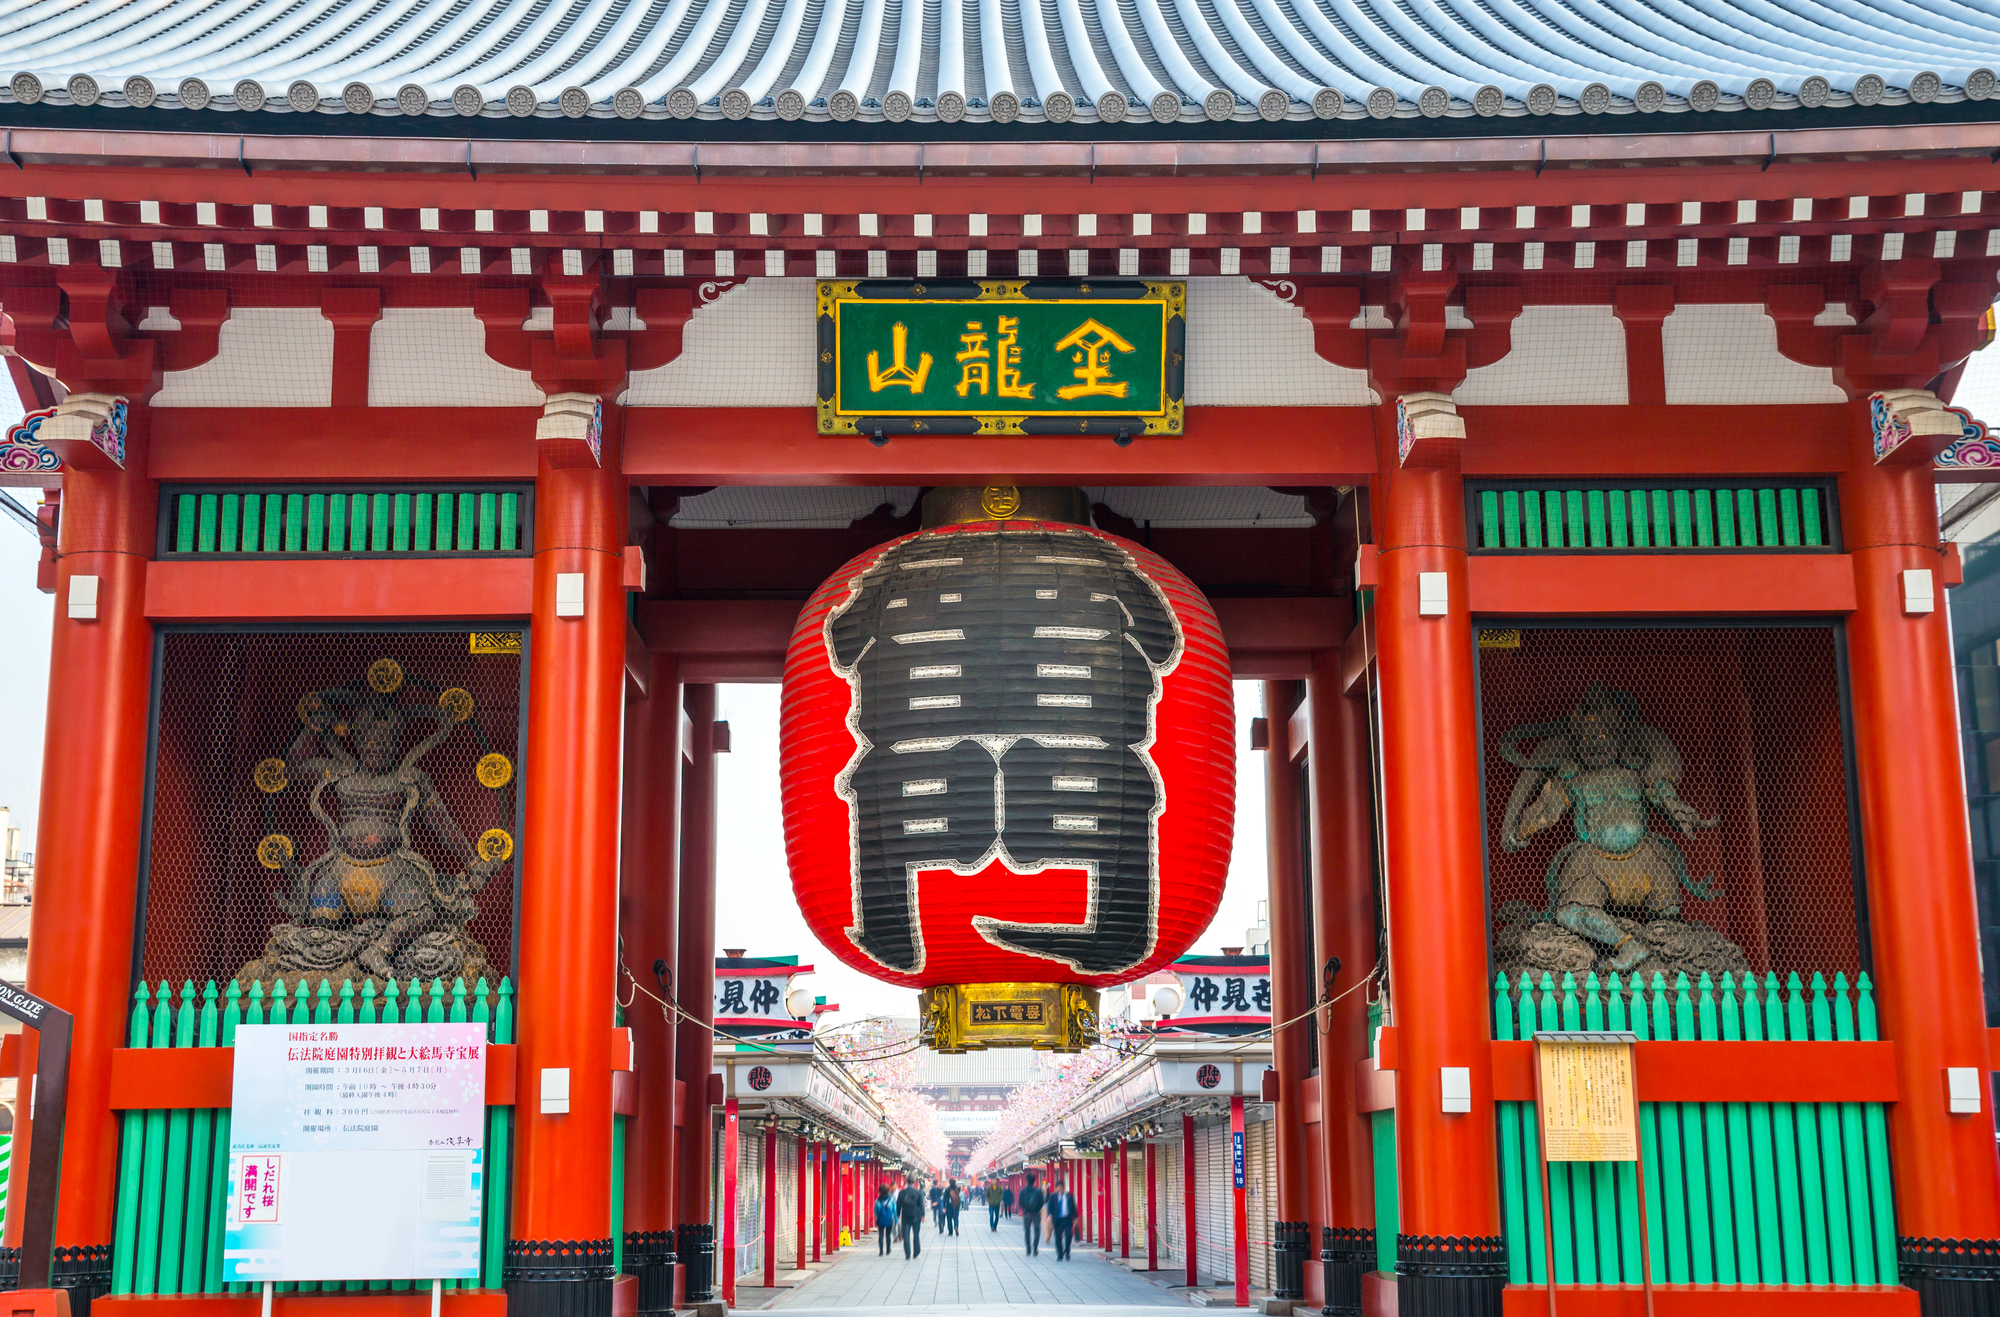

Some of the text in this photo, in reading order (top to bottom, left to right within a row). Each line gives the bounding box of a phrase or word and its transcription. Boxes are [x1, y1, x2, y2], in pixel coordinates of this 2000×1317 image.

[0, 984, 44, 1015] ON GATE
[713, 979, 780, 1014] 仲見
[975, 1004, 1041, 1021] 松下電器
[288, 1031, 339, 1042] 国指定名勝
[287, 1045, 480, 1061] 伝法院庭園特別拝観と大絵馬寺宝展
[243, 1165, 258, 1218] 満開です
[262, 1158, 275, 1207] しだれ桜
